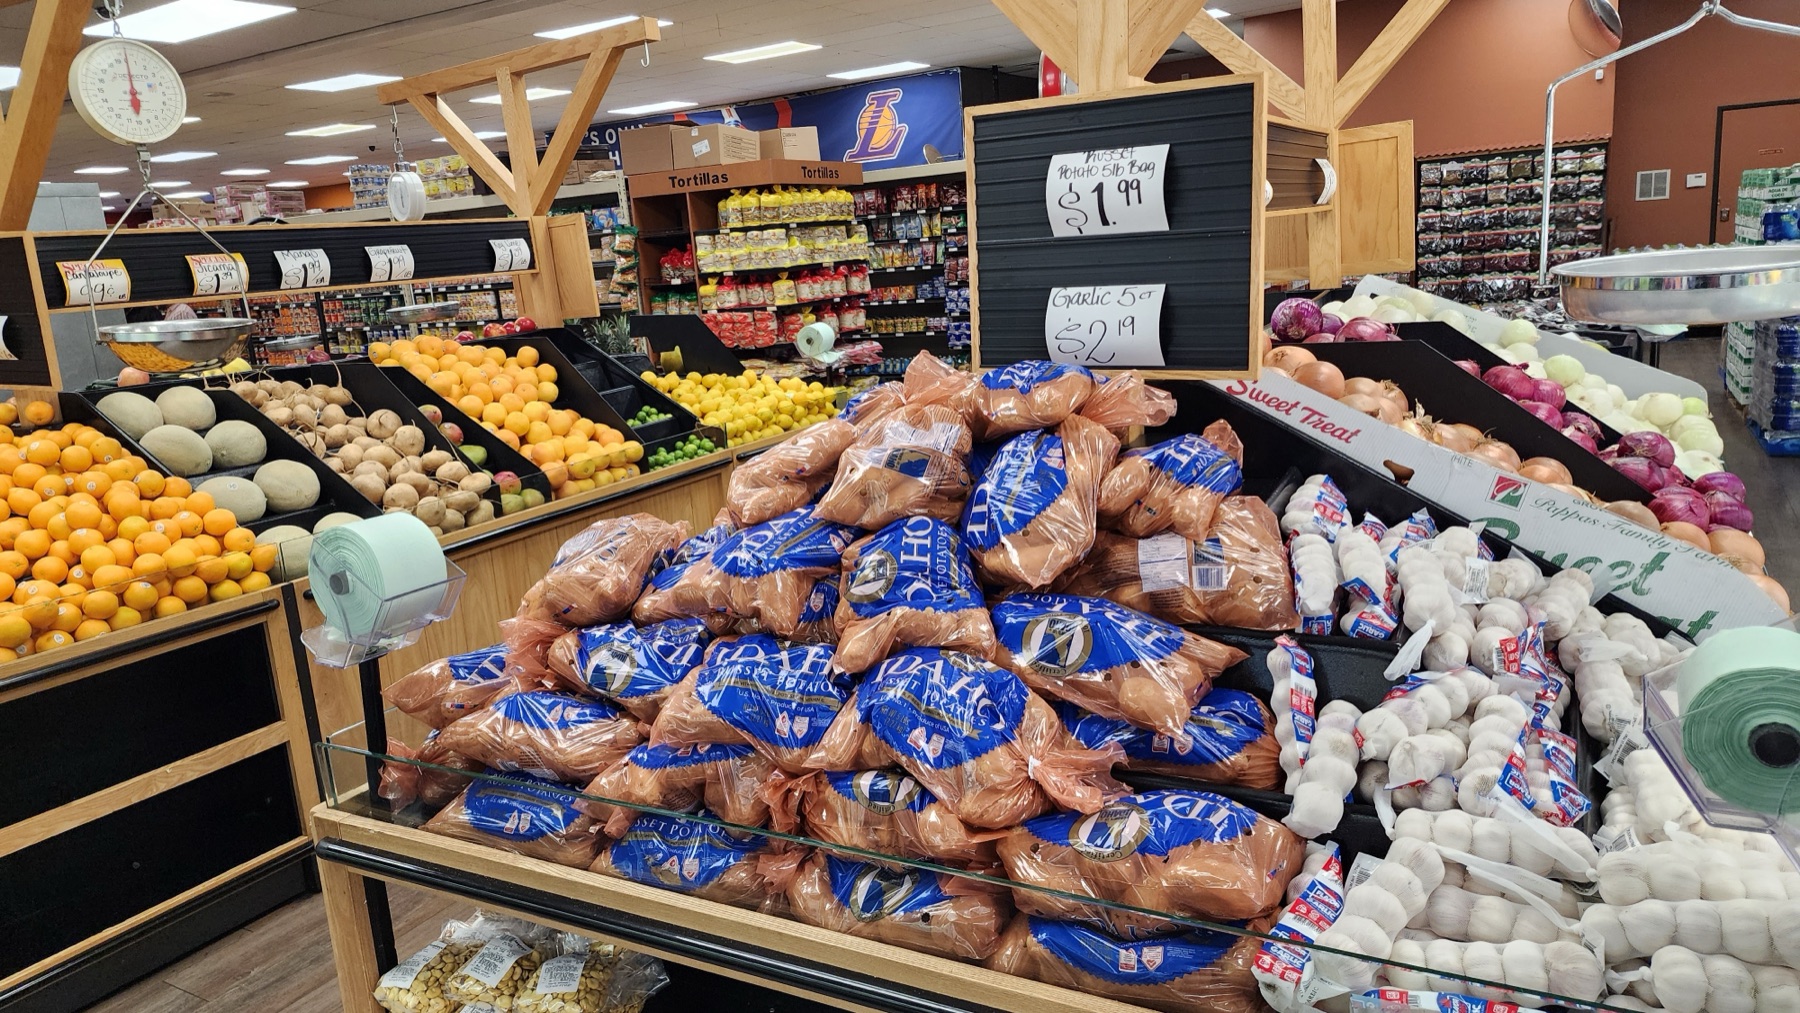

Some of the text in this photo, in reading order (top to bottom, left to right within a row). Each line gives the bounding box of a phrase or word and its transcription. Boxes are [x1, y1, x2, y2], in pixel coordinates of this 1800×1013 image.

[669, 172, 729, 189] Tortillas
[801, 165, 840, 179] Tortillas
[1057, 164, 1099, 180] Potato
[1127, 159, 1156, 180] Bag
[1225, 379, 1362, 444] Sweet Treat
[1530, 498, 1601, 526] Pappas
[1602, 519, 1672, 550] Family
[1270, 945, 1304, 968] GARLIC
